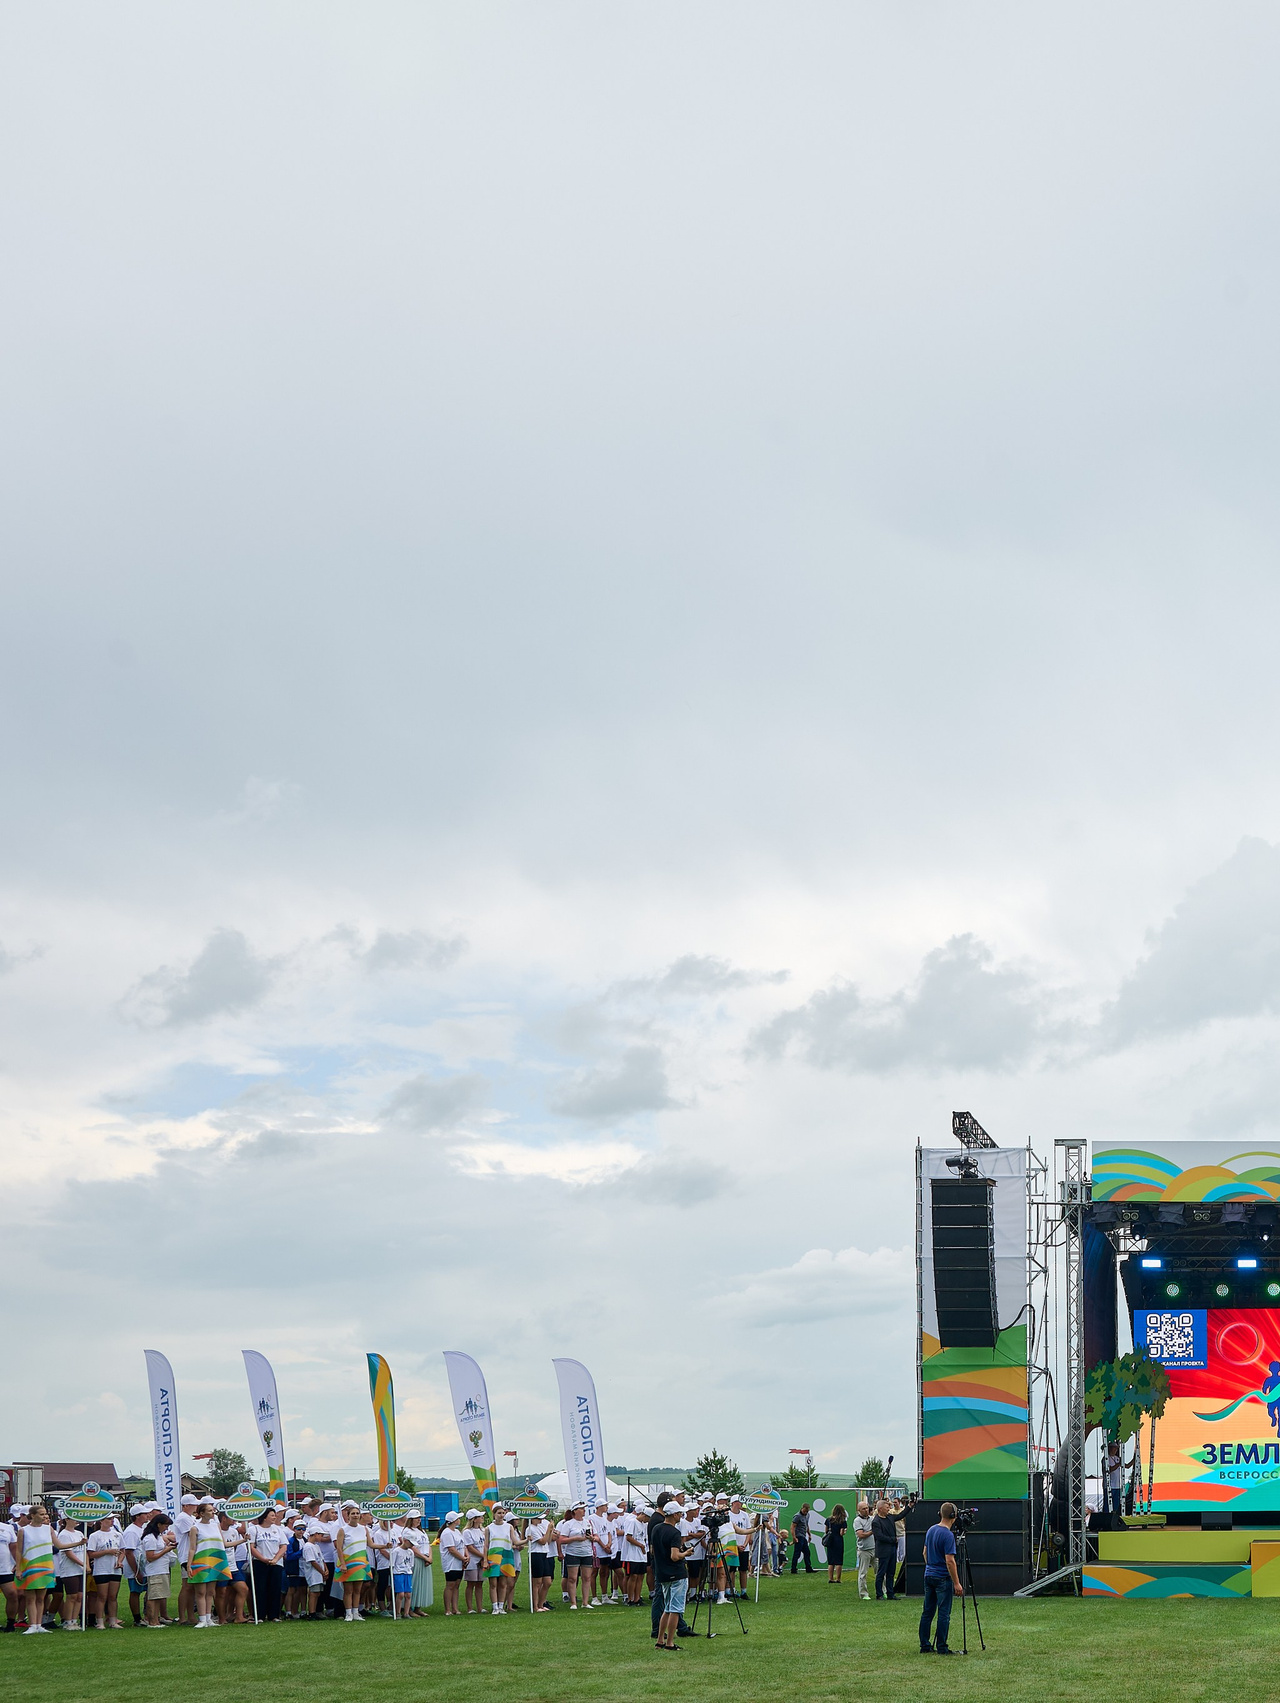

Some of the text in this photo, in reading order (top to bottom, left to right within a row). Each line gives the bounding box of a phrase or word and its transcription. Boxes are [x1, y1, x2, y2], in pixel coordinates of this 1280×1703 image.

[58, 1500, 122, 1510] Зональный
[219, 1499, 274, 1510] Калманский
[504, 1500, 557, 1508] Крутихинский
[232, 1510, 260, 1518] район
